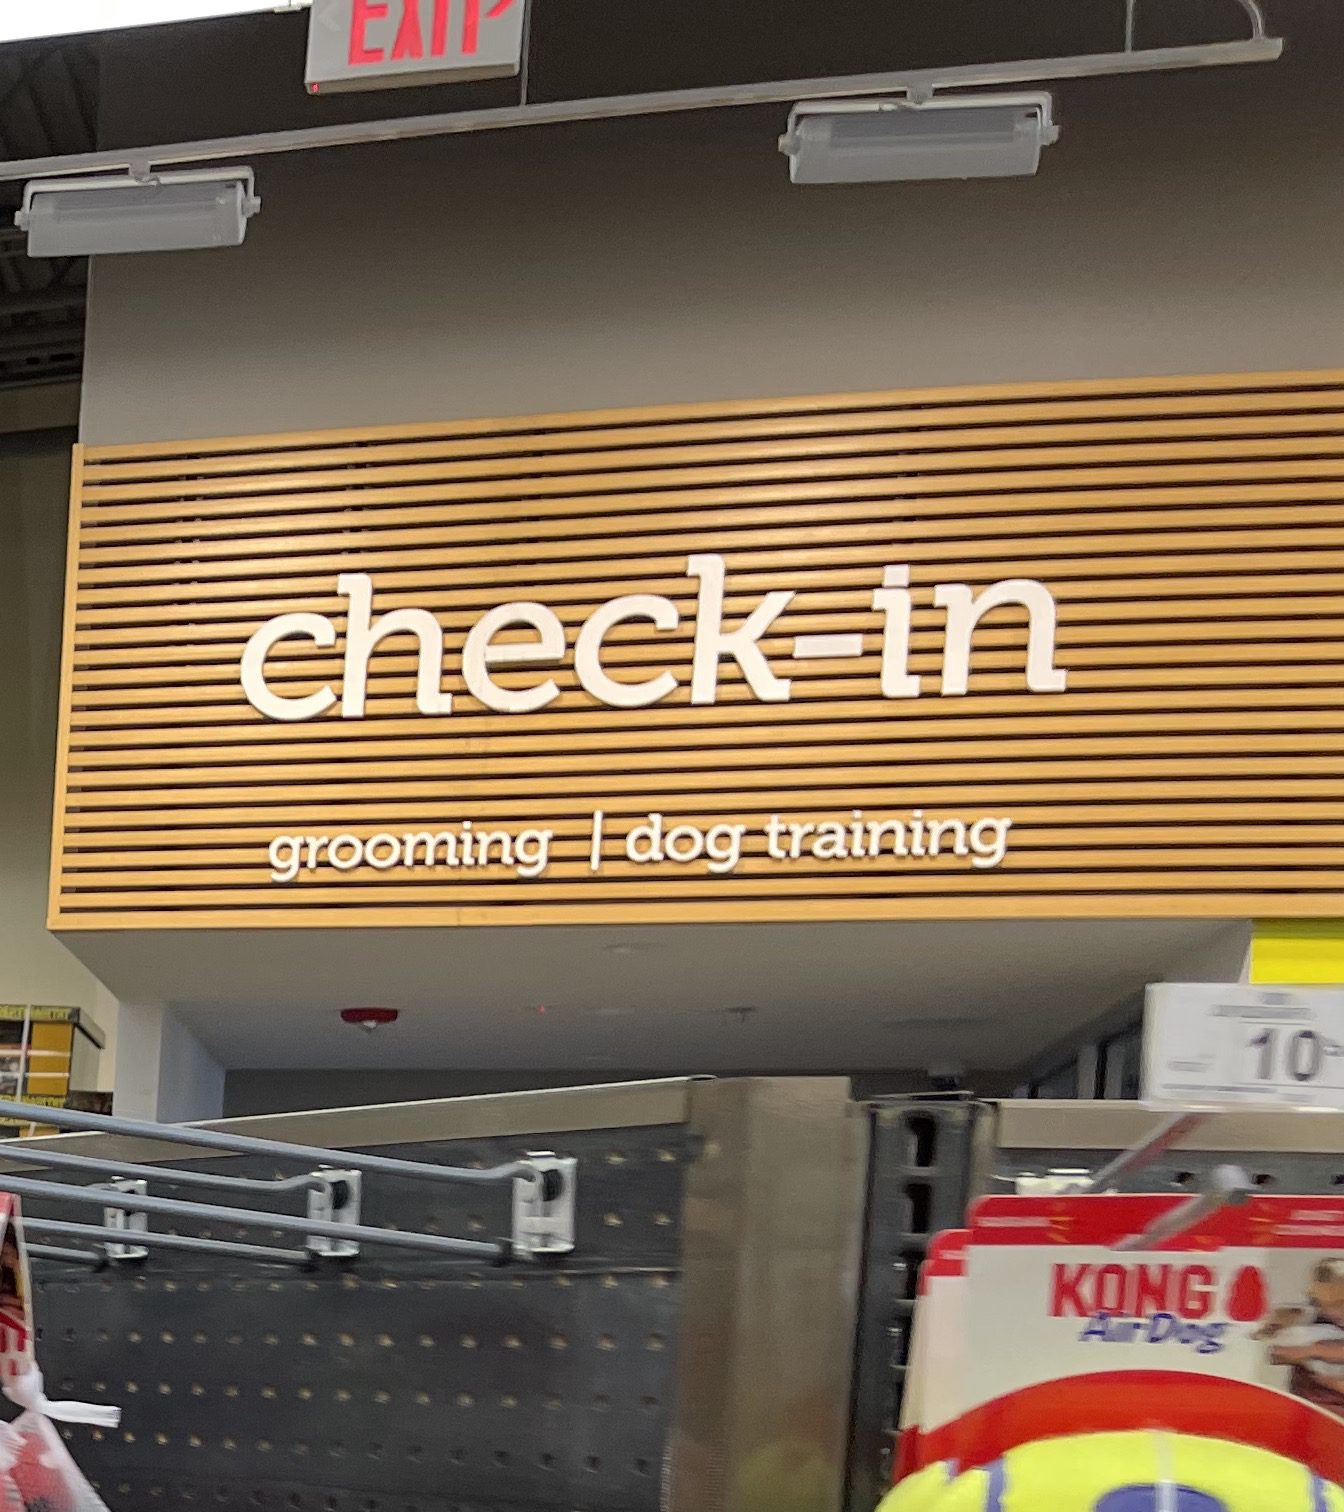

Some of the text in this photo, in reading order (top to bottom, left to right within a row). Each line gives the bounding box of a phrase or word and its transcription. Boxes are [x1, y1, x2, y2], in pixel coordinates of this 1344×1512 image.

[240, 553, 1065, 719] check-in
[267, 808, 1012, 882] grooming dog training
[1048, 1262, 1218, 1320] KONG
